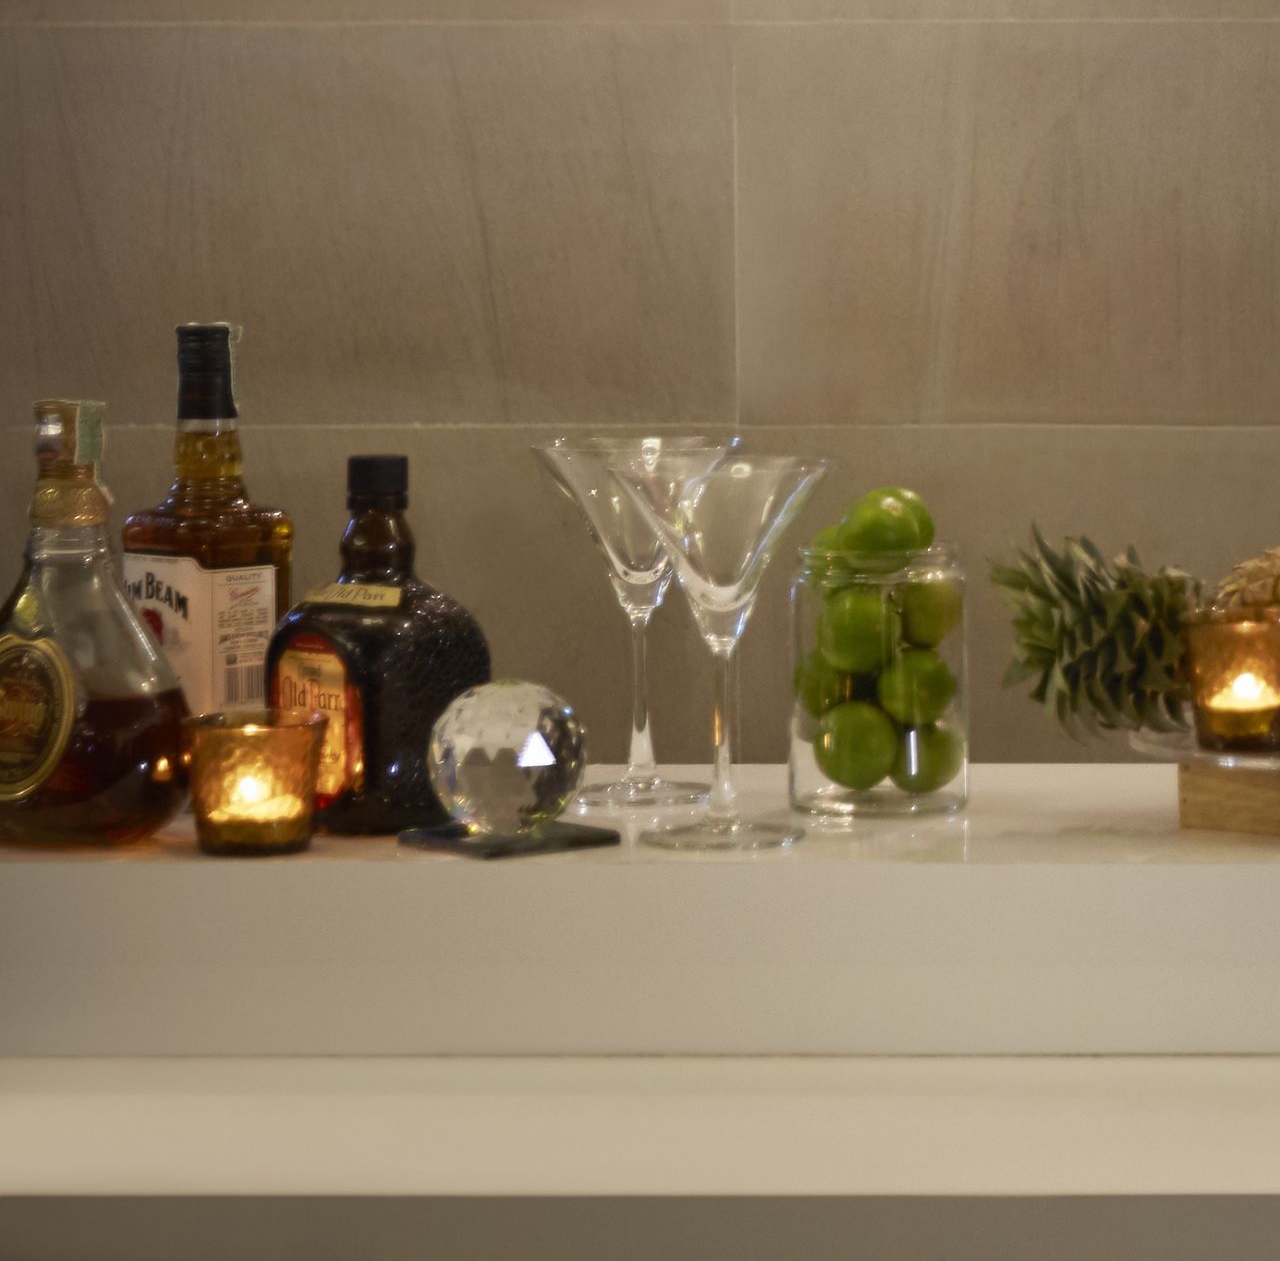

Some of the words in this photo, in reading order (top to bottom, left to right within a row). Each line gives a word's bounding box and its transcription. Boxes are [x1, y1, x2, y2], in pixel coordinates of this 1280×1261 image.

[226, 572, 262, 583] QUALITY
[145, 572, 189, 621] BEAM
[351, 588, 385, 602] Parr
[281, 675, 306, 711] Old
[306, 678, 341, 712] Parr
